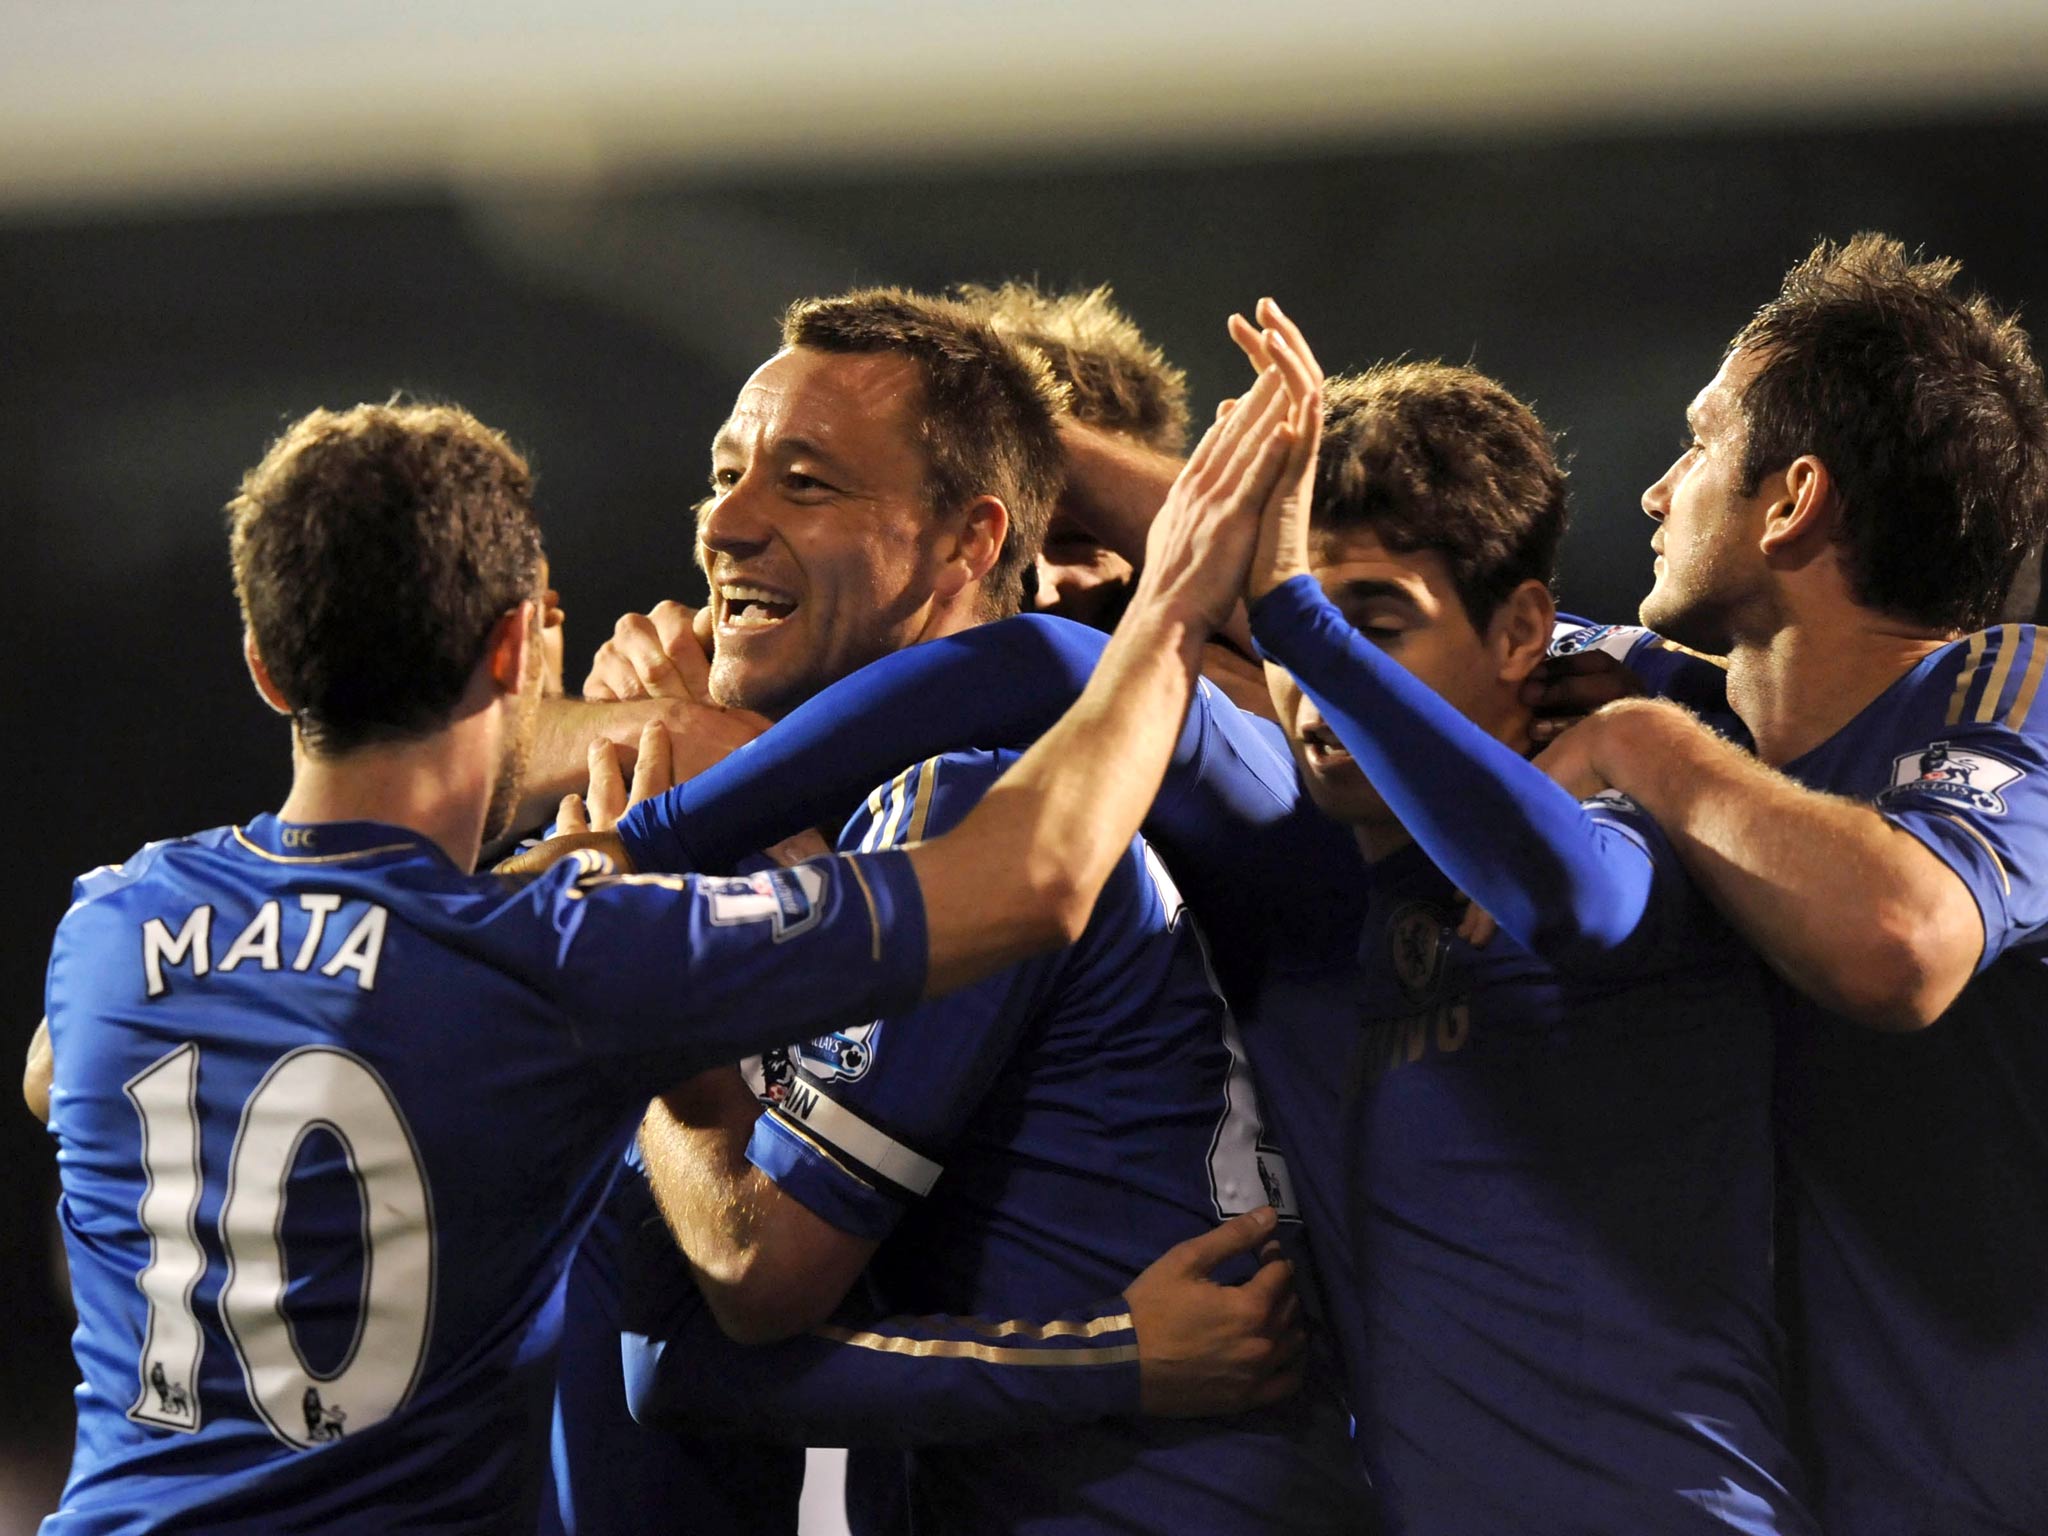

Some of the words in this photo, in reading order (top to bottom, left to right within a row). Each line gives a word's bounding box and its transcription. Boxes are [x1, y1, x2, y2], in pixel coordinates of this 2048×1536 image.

[281, 828, 315, 847] CFC
[142, 894, 389, 998] MATA
[124, 1041, 437, 1452] 10
